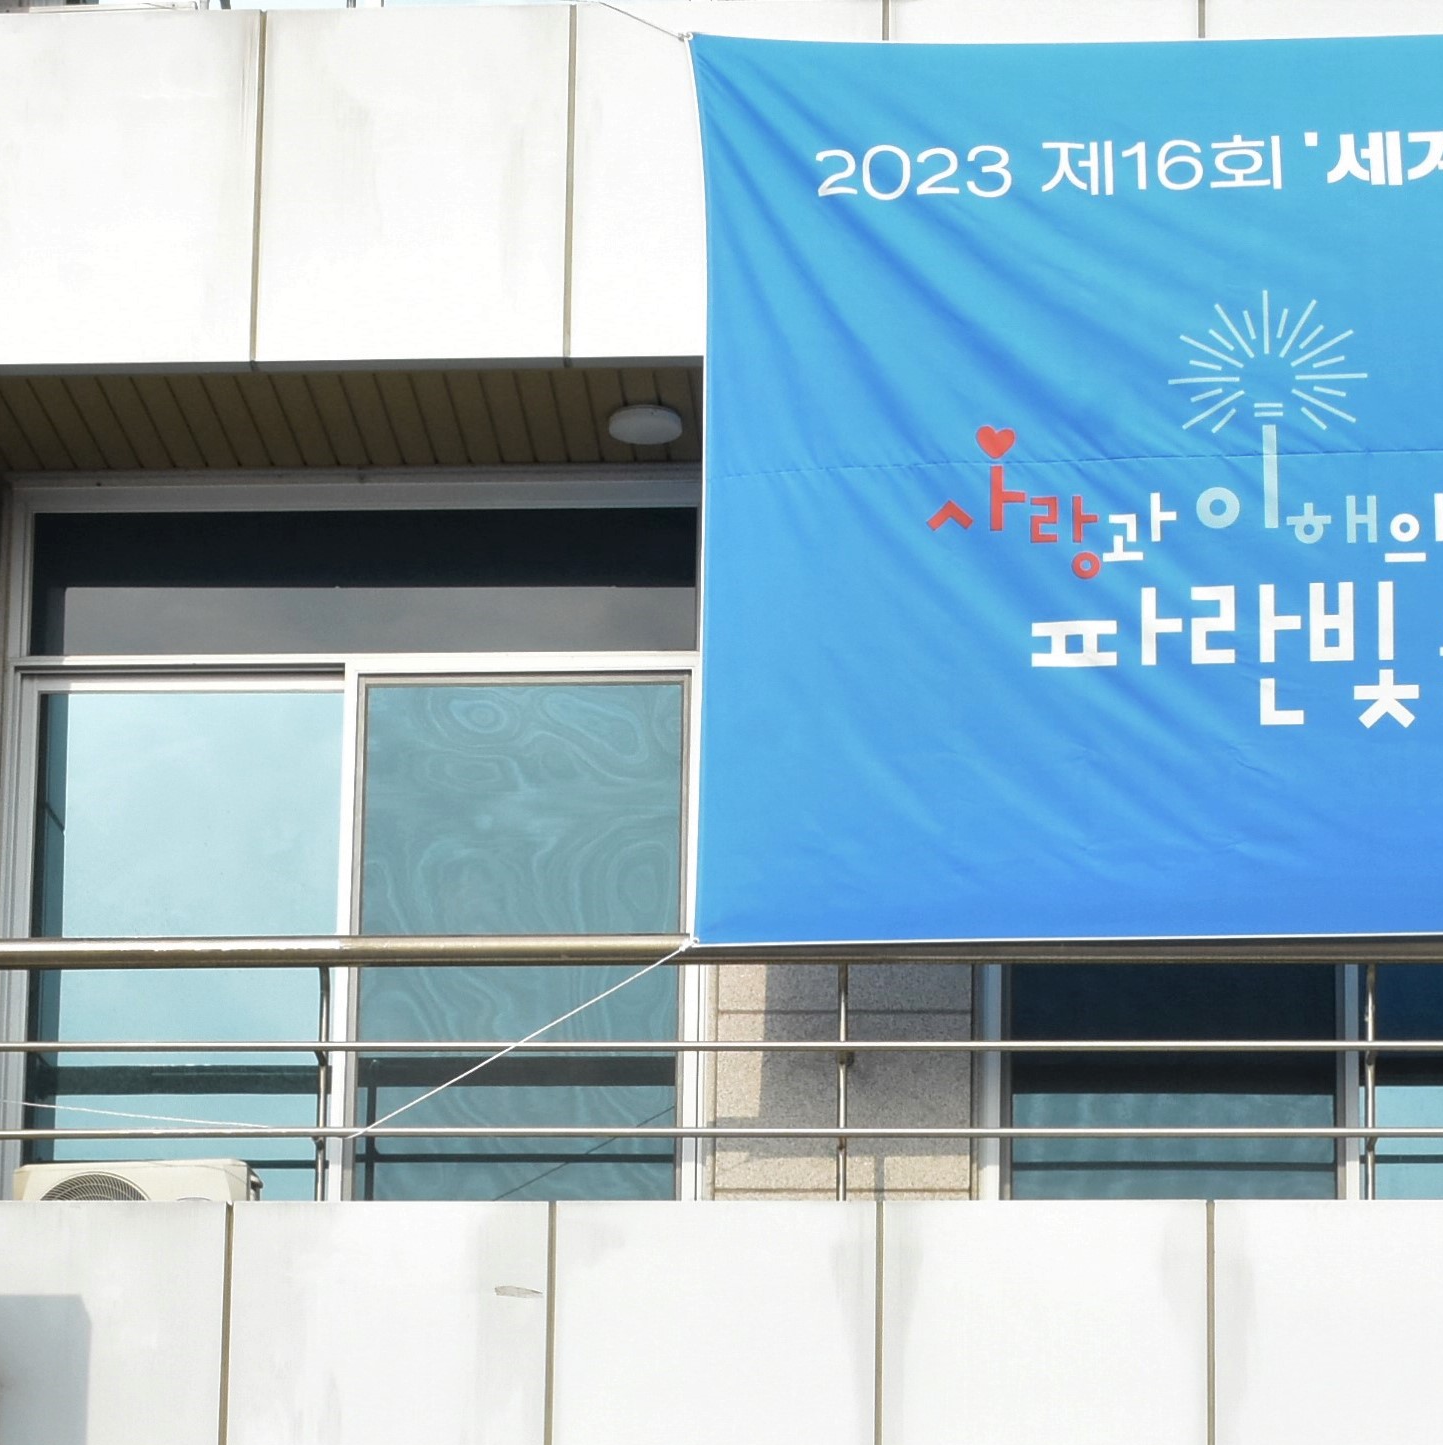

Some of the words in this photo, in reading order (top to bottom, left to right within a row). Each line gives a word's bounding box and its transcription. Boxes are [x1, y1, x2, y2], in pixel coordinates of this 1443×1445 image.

[816, 144, 1012, 201] 2023
[1041, 134, 1283, 197] 제16회
[927, 463, 1177, 580] 사랑과
